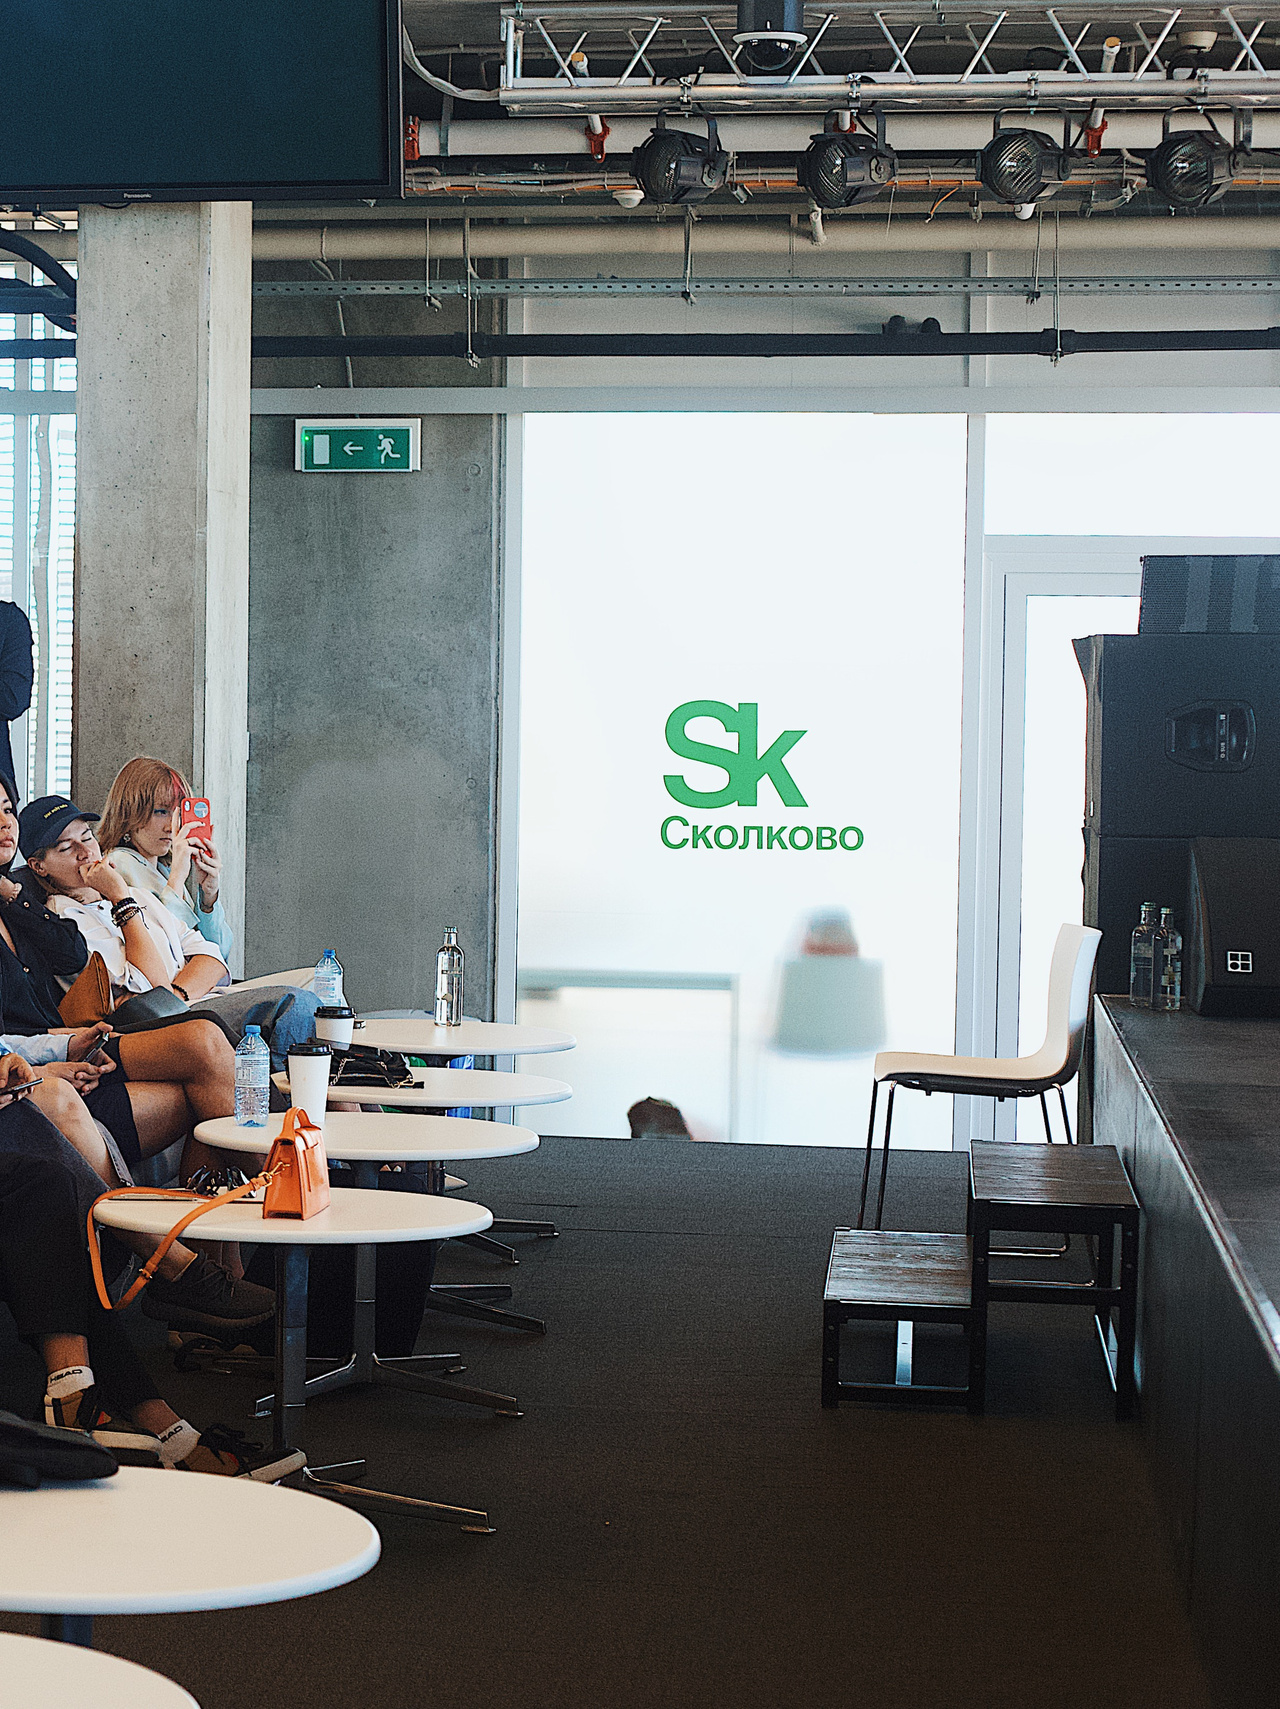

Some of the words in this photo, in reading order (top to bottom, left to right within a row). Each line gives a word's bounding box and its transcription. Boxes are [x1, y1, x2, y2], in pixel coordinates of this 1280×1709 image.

[663, 699, 809, 809] Sk
[660, 815, 865, 851] Сколково
[50, 1368, 83, 1383] HEAD
